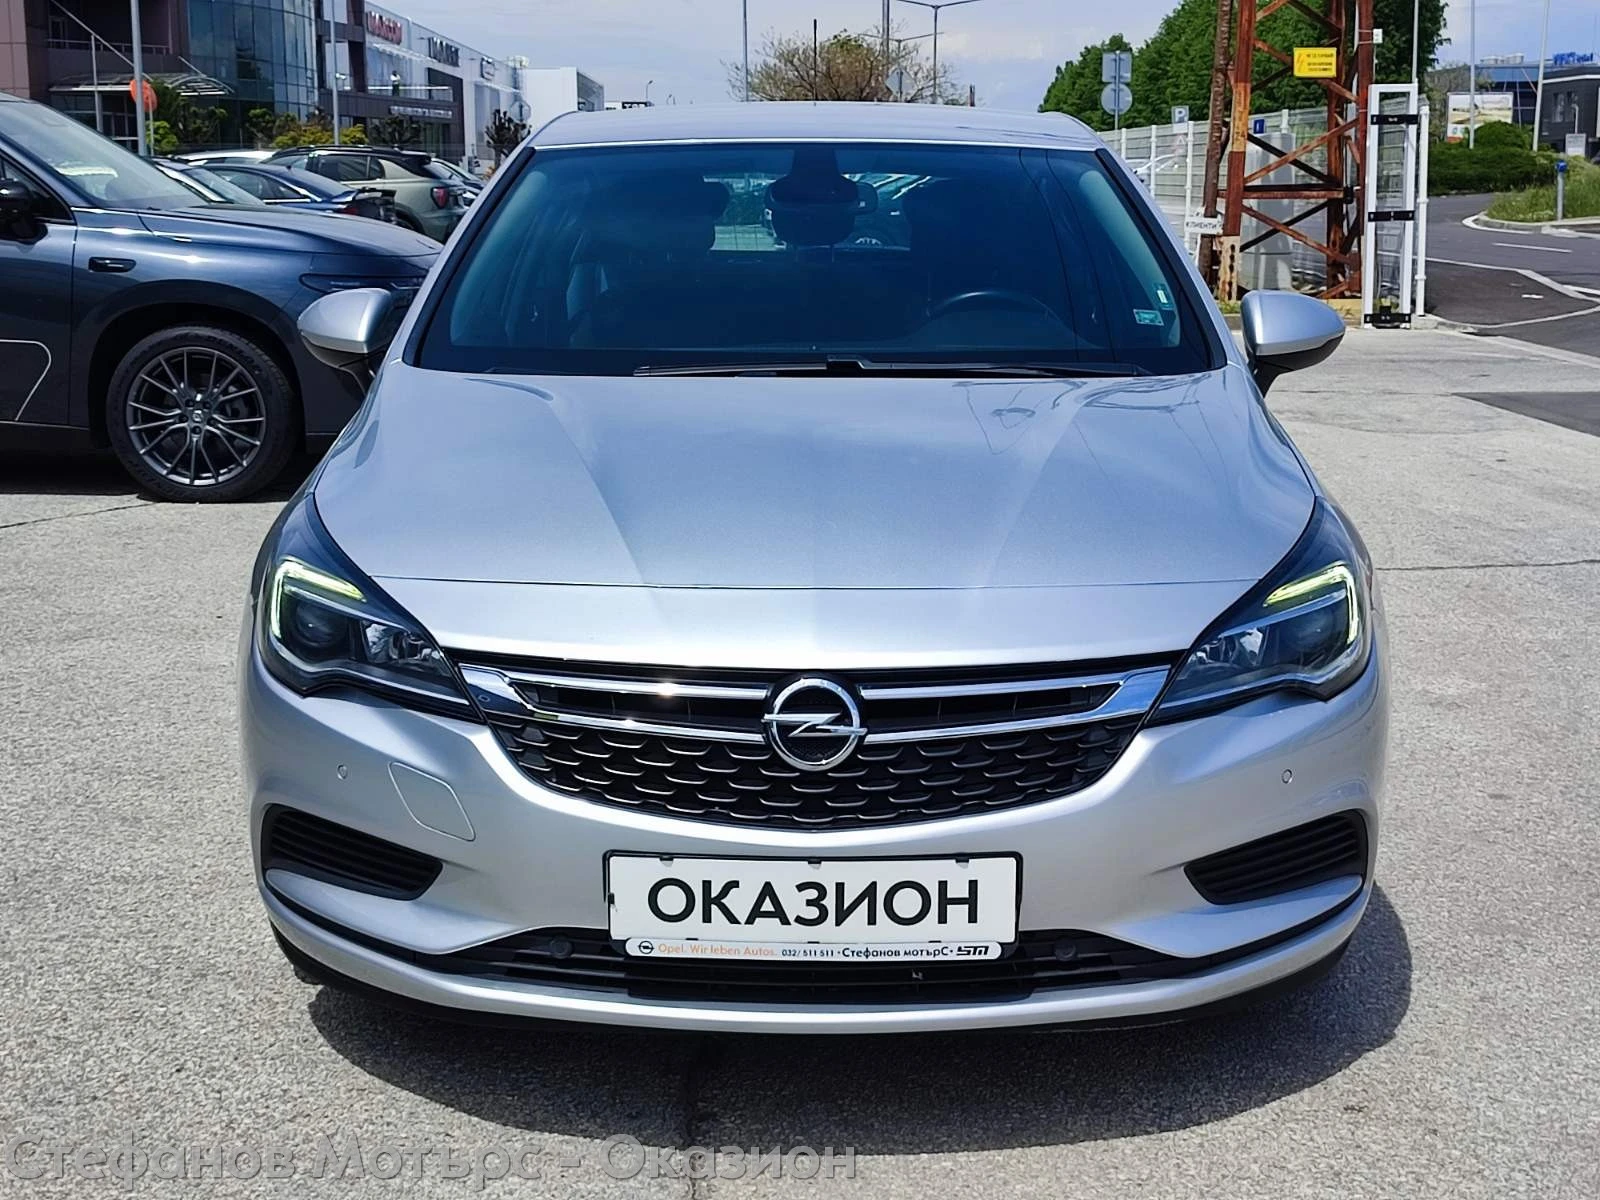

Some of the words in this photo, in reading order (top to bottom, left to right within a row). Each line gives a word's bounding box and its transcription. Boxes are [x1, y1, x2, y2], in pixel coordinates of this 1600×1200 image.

[1175, 107, 1186, 123] P
[647, 877, 979, 926] ОКАЗИОН
[690, 944, 708, 954] Wir
[711, 945, 740, 955] leben
[803, 949, 817, 957] 511
[820, 948, 834, 957] 511
